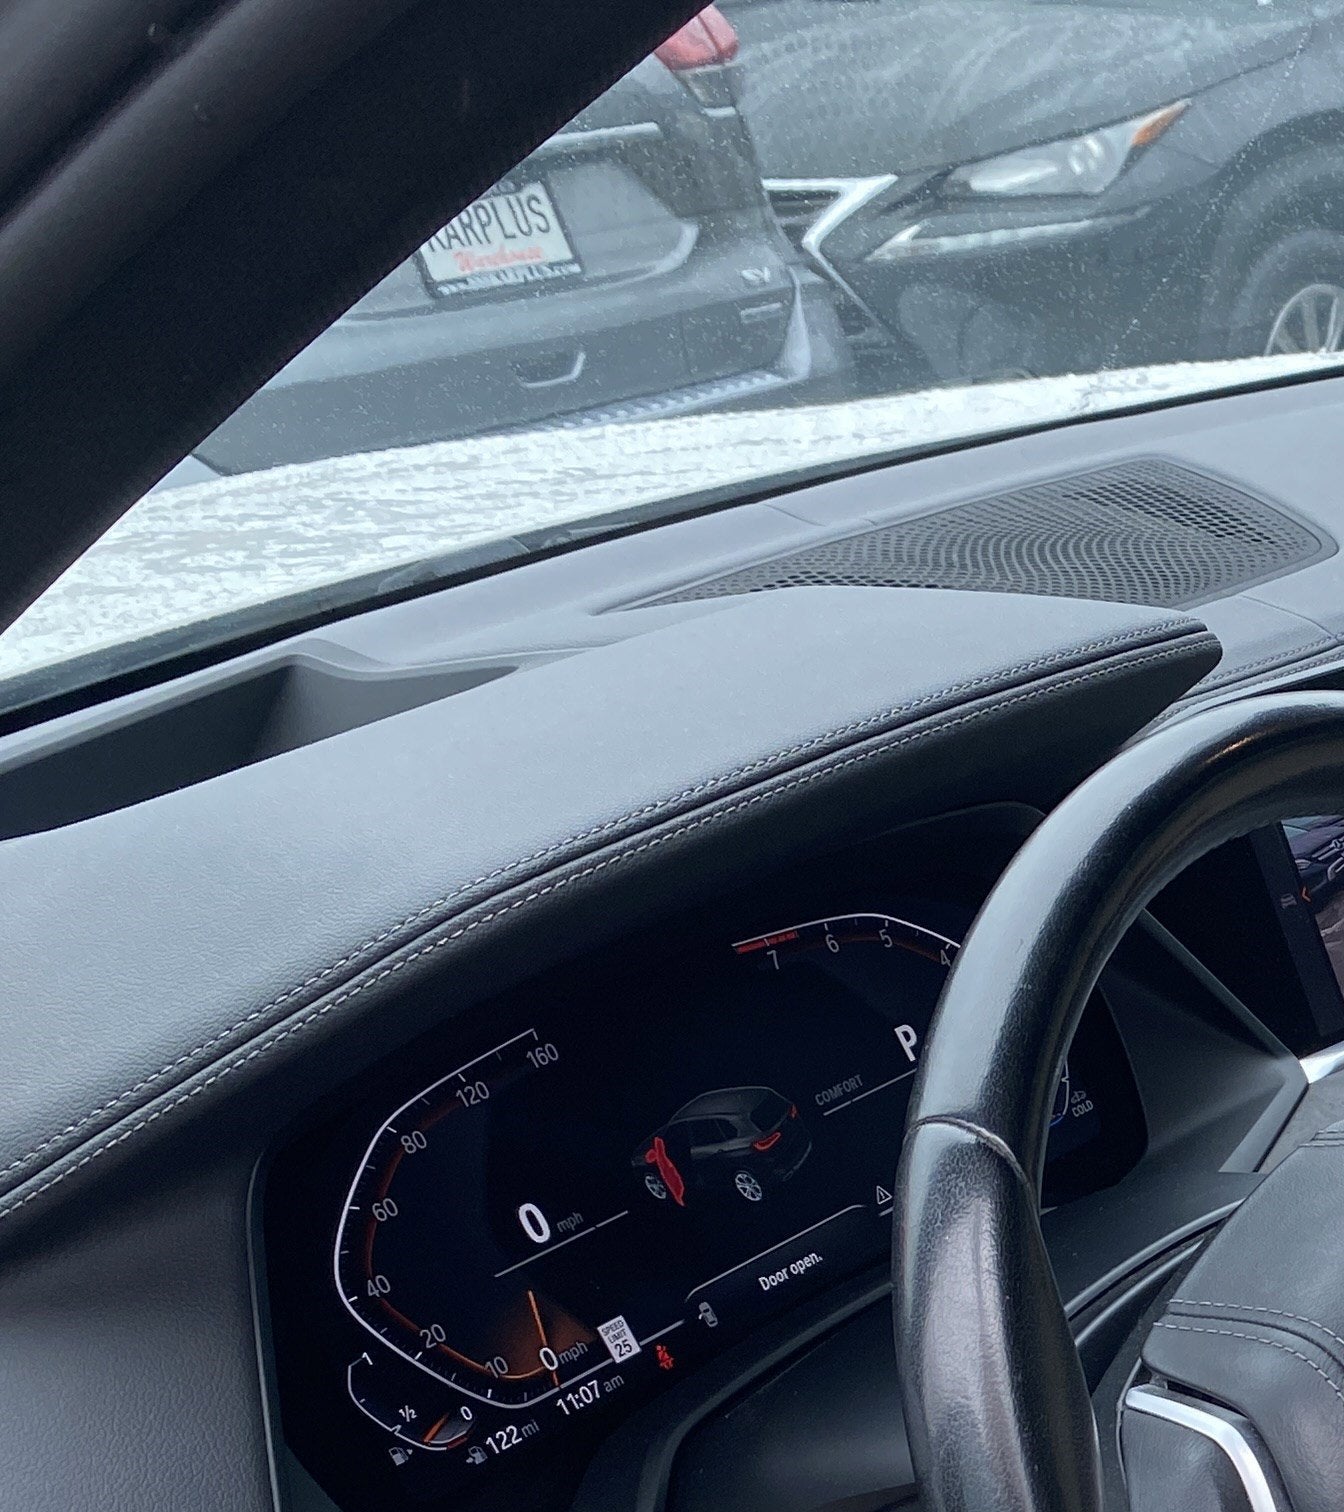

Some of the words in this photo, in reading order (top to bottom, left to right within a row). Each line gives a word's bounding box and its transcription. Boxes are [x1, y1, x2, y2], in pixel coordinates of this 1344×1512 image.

[825, 934, 840, 953] 6
[879, 929, 893, 948] 5
[766, 950, 780, 970] 7
[940, 949, 951, 966] 4
[894, 1024, 918, 1062] P
[526, 1043, 559, 1068] 160
[456, 1081, 490, 1107] 120
[815, 1074, 864, 1106] COMFORT
[1072, 1100, 1093, 1117] COLD
[401, 1131, 427, 1154] 80
[372, 1198, 398, 1222] 60
[518, 1203, 551, 1243] 0
[557, 1212, 584, 1233] mph
[758, 1268, 790, 1291] Door
[790, 1251, 823, 1276] open.
[367, 1275, 391, 1298] 40
[419, 1324, 446, 1348] 20
[601, 1319, 625, 1337] SPEED
[608, 1329, 627, 1344] LIMIT
[539, 1347, 558, 1371] 0
[558, 1341, 588, 1365] mph
[614, 1339, 633, 1358] 25
[485, 1356, 508, 1378] 10
[556, 1380, 602, 1415] 11:07
[603, 1374, 625, 1393] am
[460, 1406, 473, 1420] 0
[485, 1425, 523, 1454] 122
[521, 1420, 540, 1439] mi
